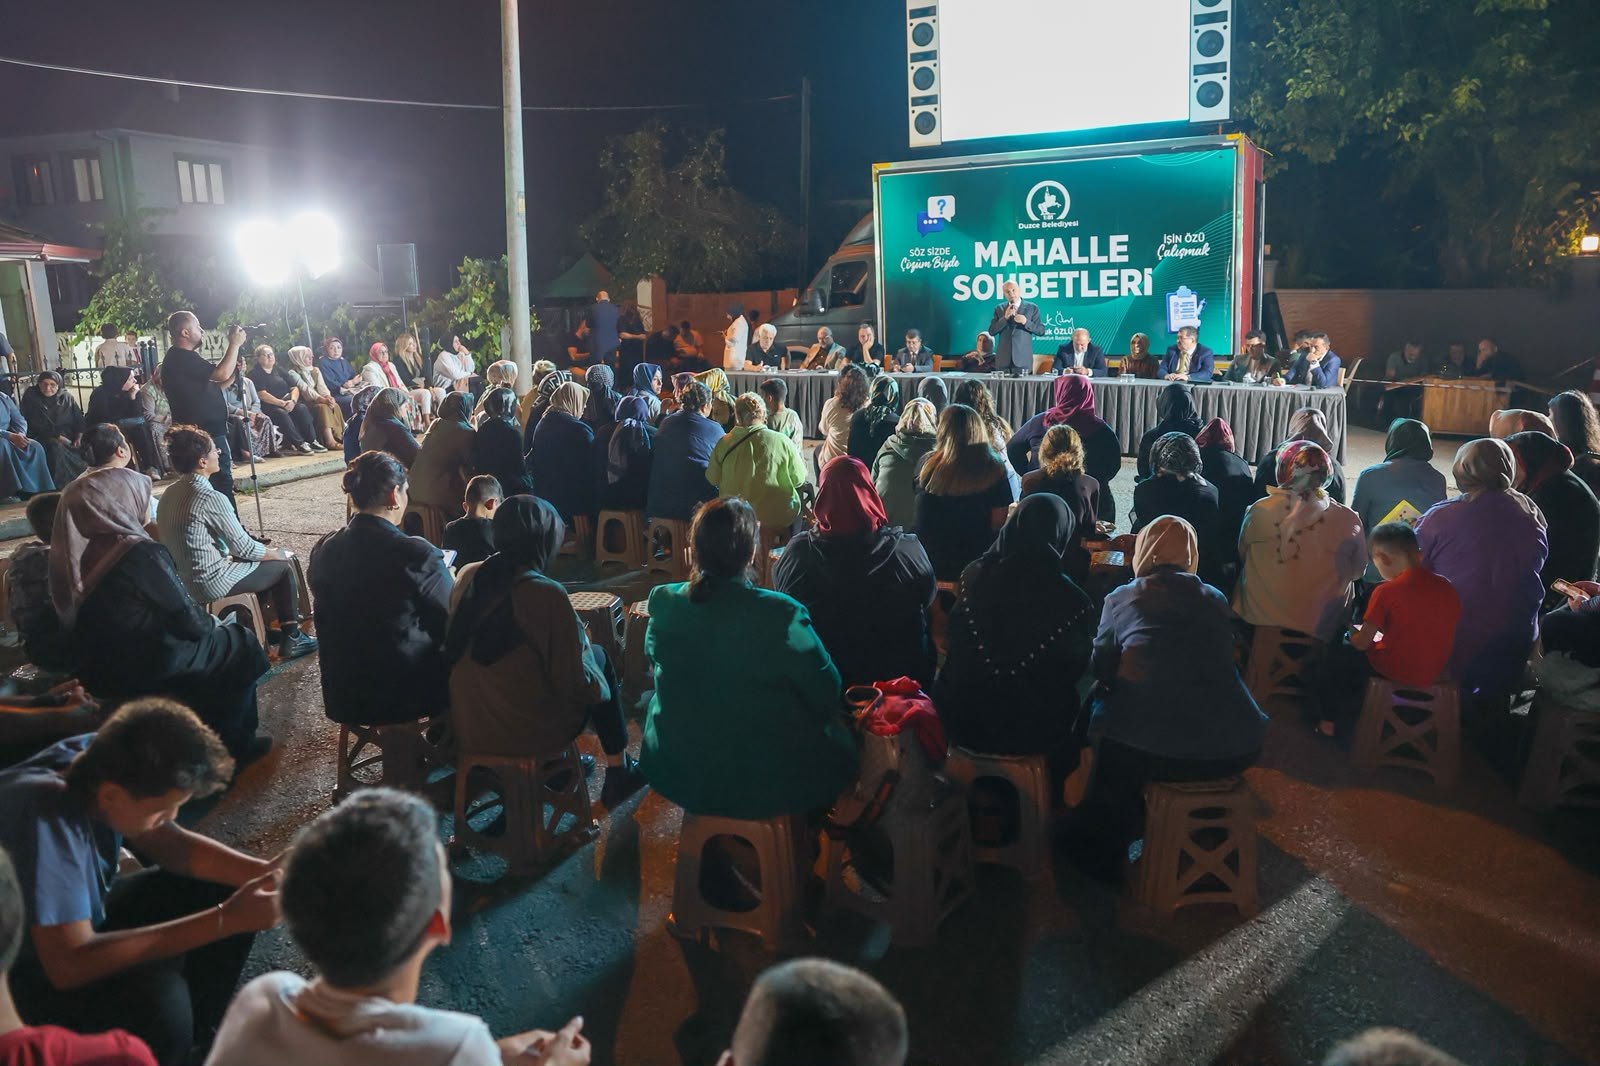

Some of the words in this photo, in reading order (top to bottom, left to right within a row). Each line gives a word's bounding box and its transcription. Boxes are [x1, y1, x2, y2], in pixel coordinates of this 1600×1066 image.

[1041, 220, 1079, 229] Belediyesi
[1184, 231, 1206, 243] ÖZÜ
[909, 246, 926, 257] SÖZ
[927, 246, 951, 256] SİZDE
[974, 234, 1129, 268] MAHALLE
[900, 257, 932, 273] Çözüm
[932, 255, 960, 272] Bizde
